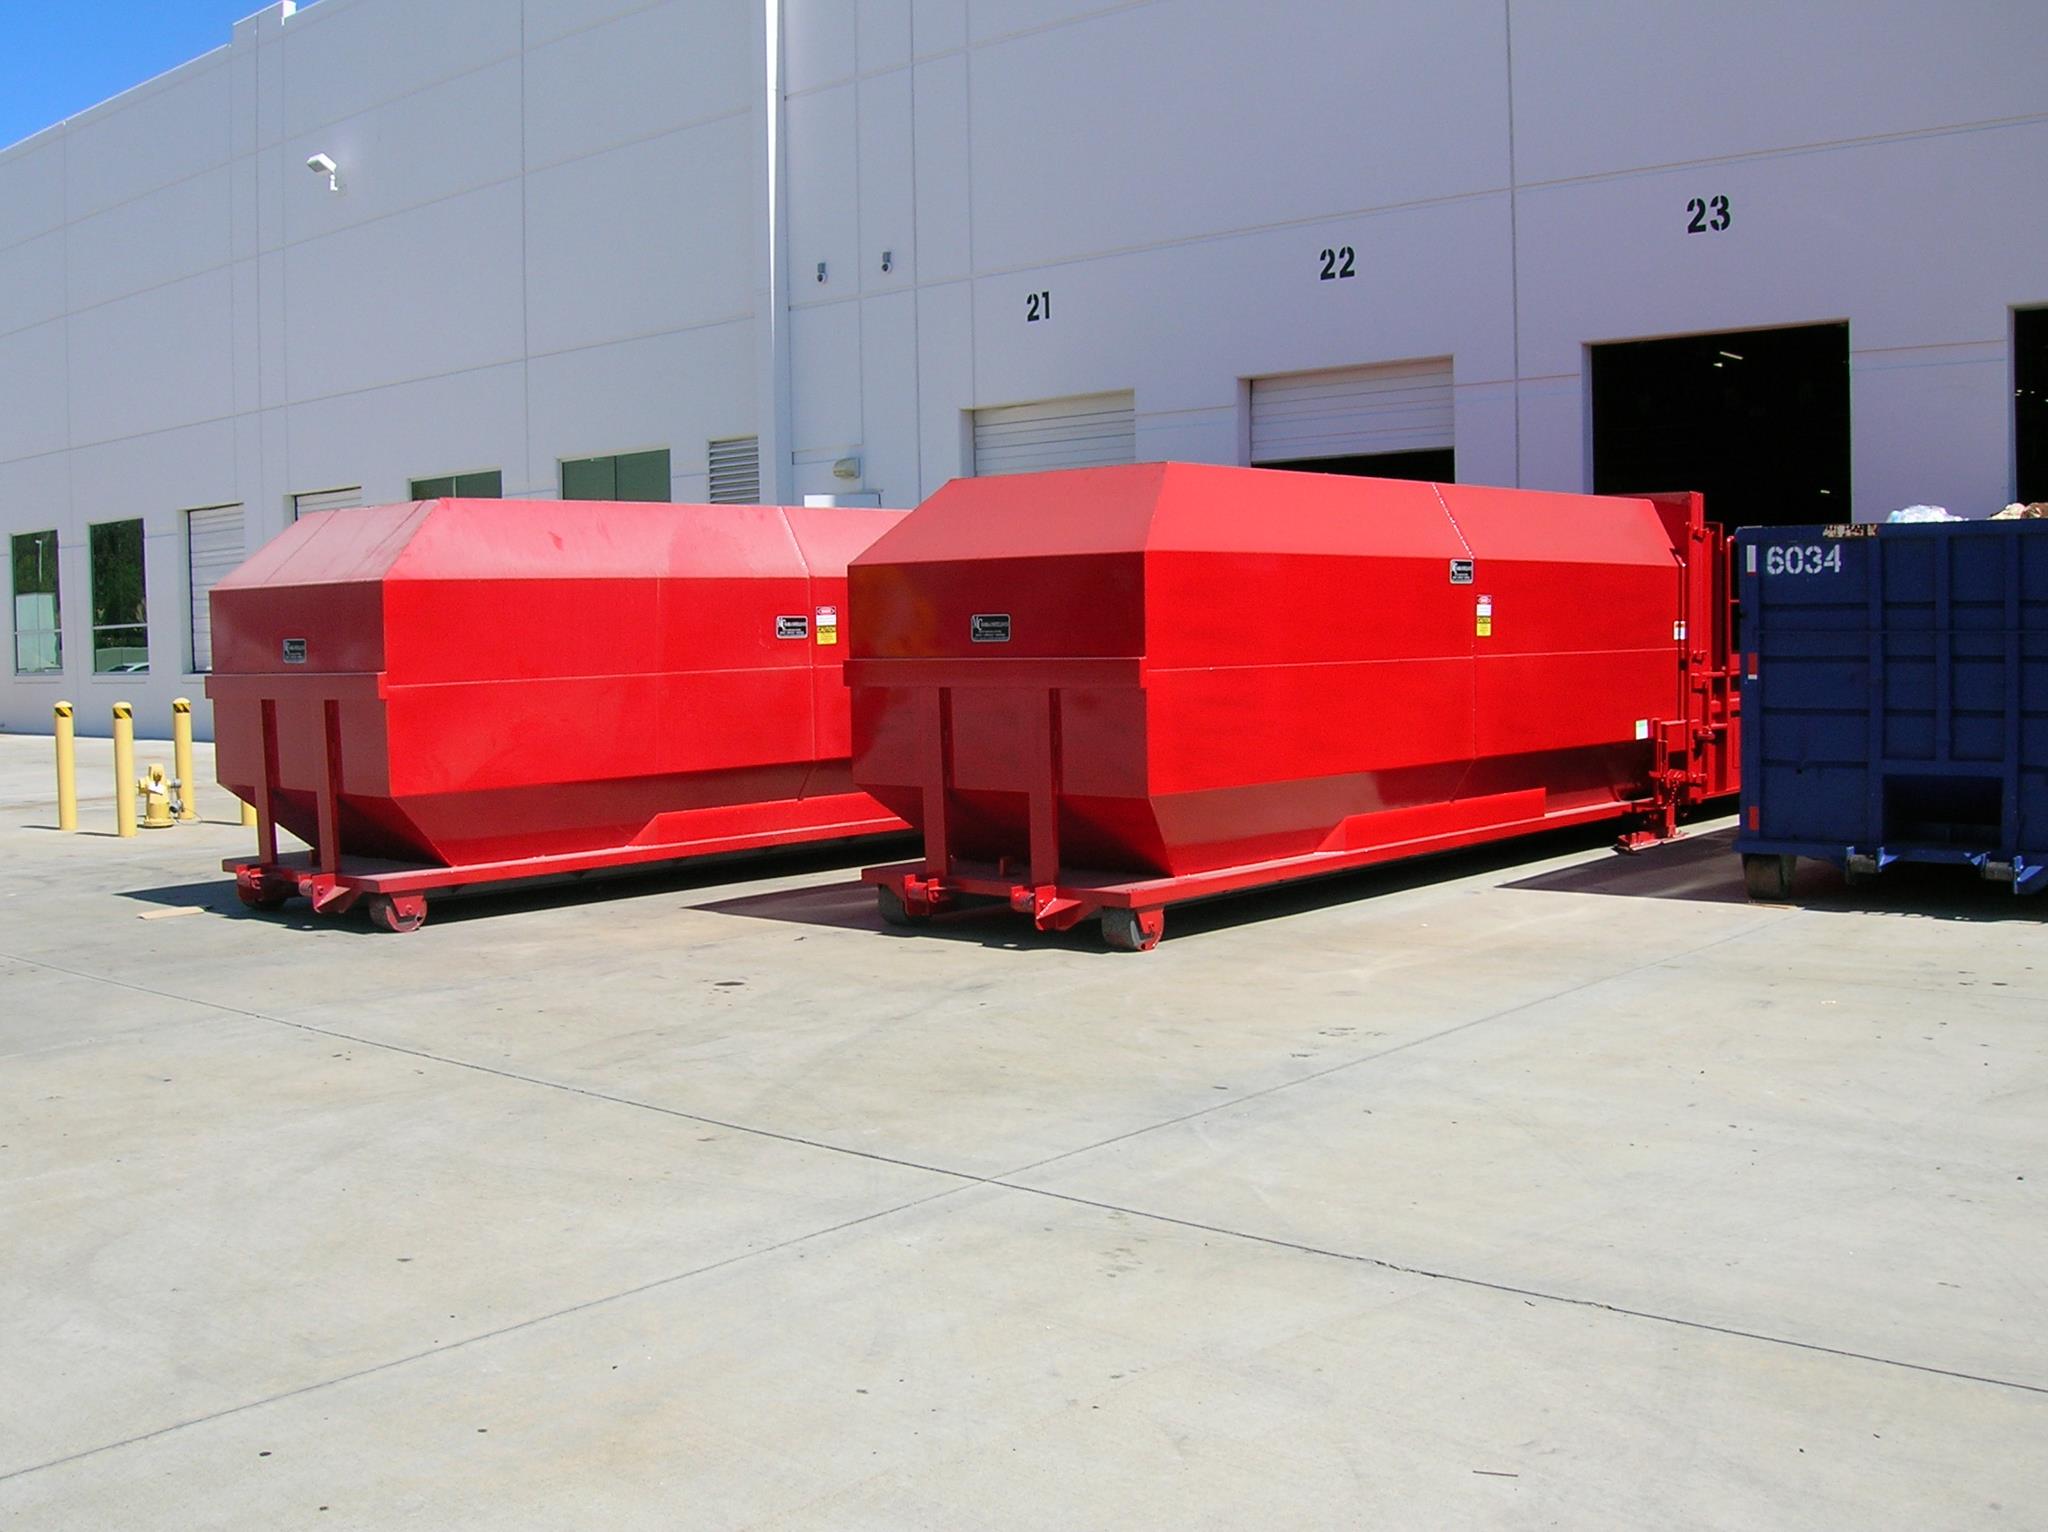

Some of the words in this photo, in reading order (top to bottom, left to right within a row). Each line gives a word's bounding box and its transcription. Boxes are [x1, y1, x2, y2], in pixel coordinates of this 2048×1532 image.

[1687, 195, 1731, 233] 23
[1320, 247, 1356, 280] 22
[1027, 291, 1050, 321] 21
[1766, 545, 1842, 574] 6034
